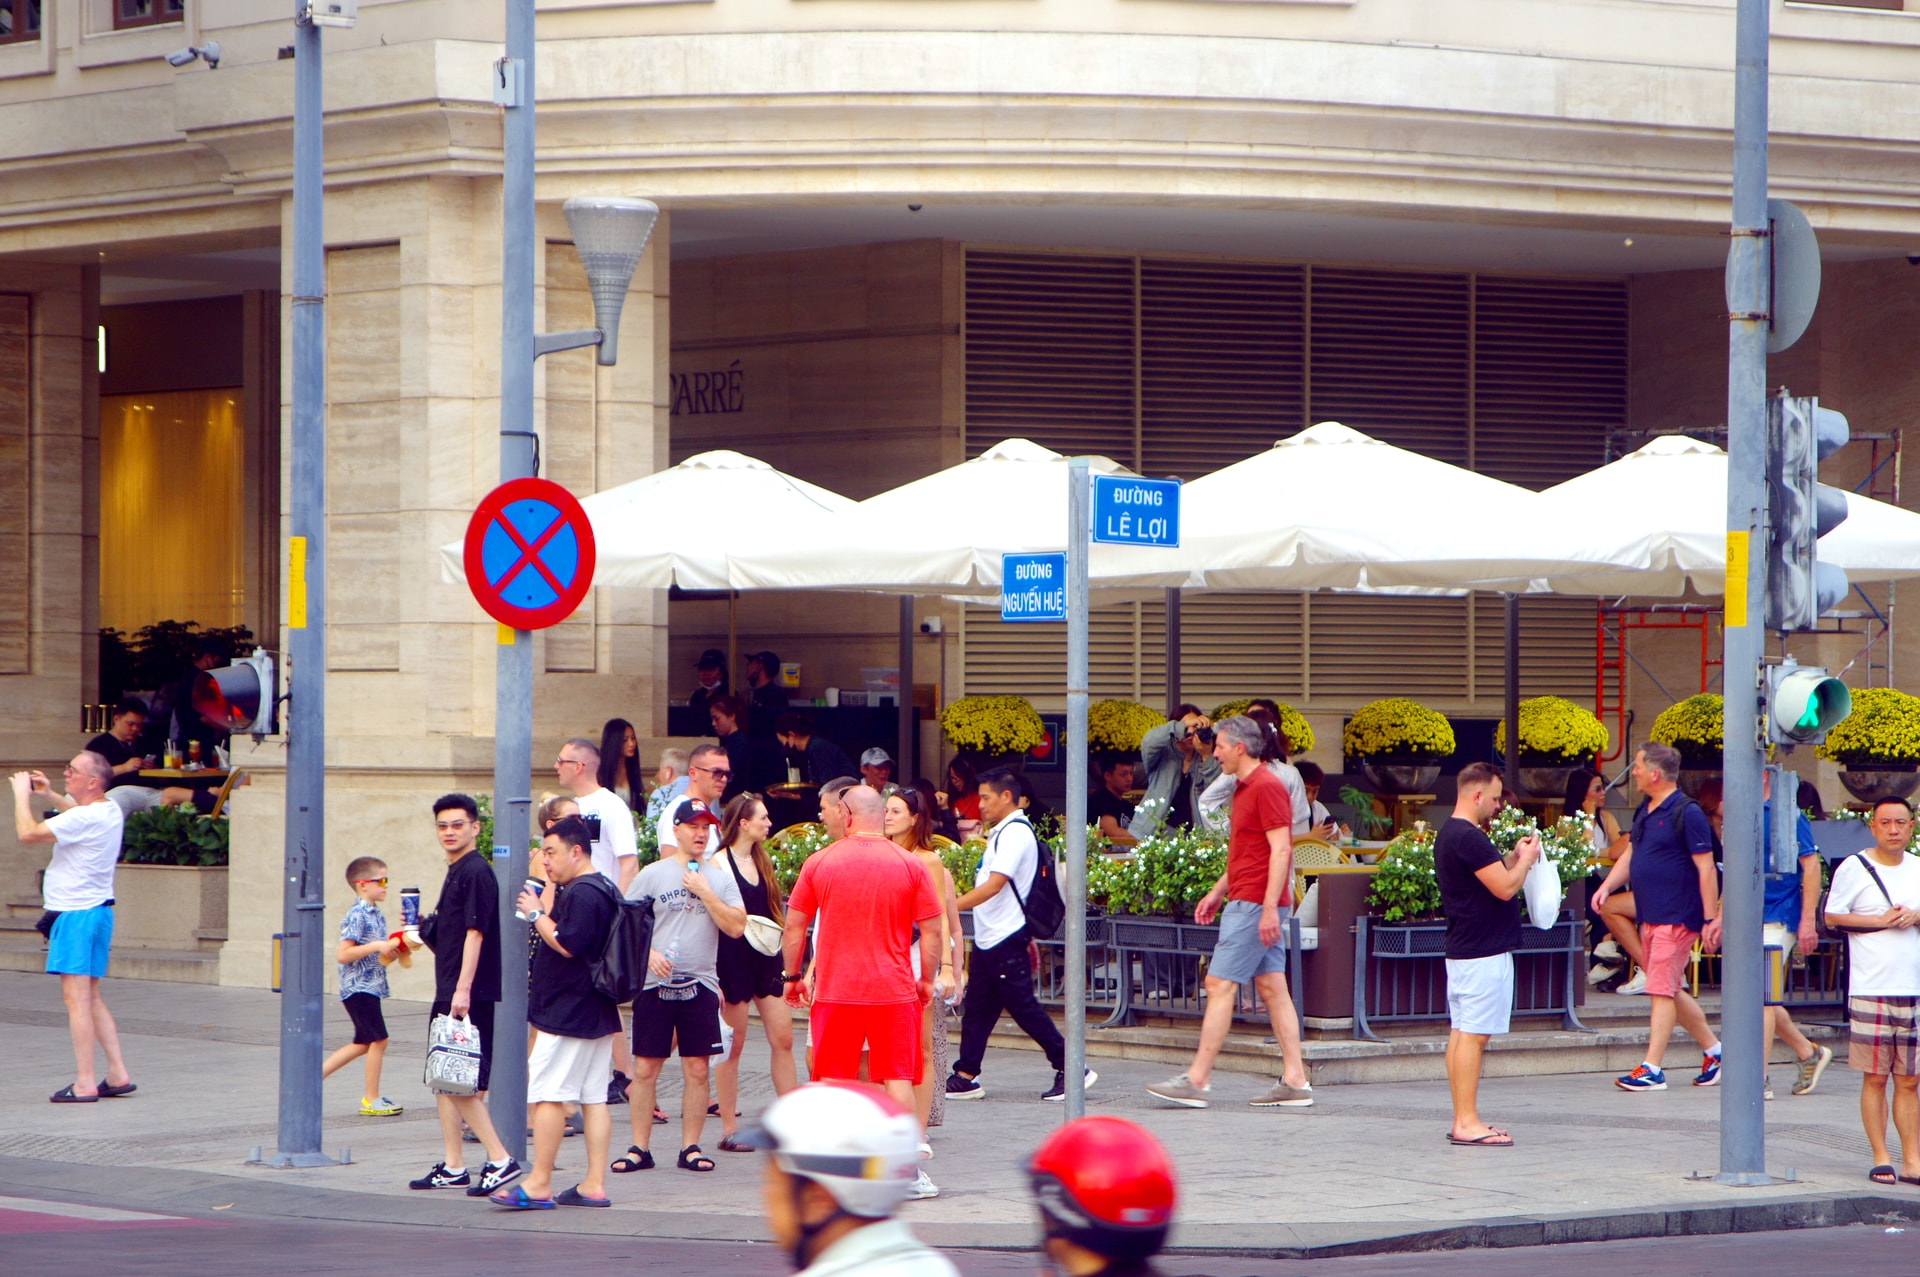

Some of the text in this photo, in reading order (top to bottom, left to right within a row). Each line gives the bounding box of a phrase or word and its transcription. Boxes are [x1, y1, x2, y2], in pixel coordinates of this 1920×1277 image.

[1113, 485, 1163, 506] ĐƯỜNG
[1107, 511, 1167, 543] LÊ LỢI
[1015, 560, 1053, 580] ĐƯỜNG
[1004, 585, 1063, 615] NGUYỄN HUỆ
[660, 888, 687, 903] BHPC
